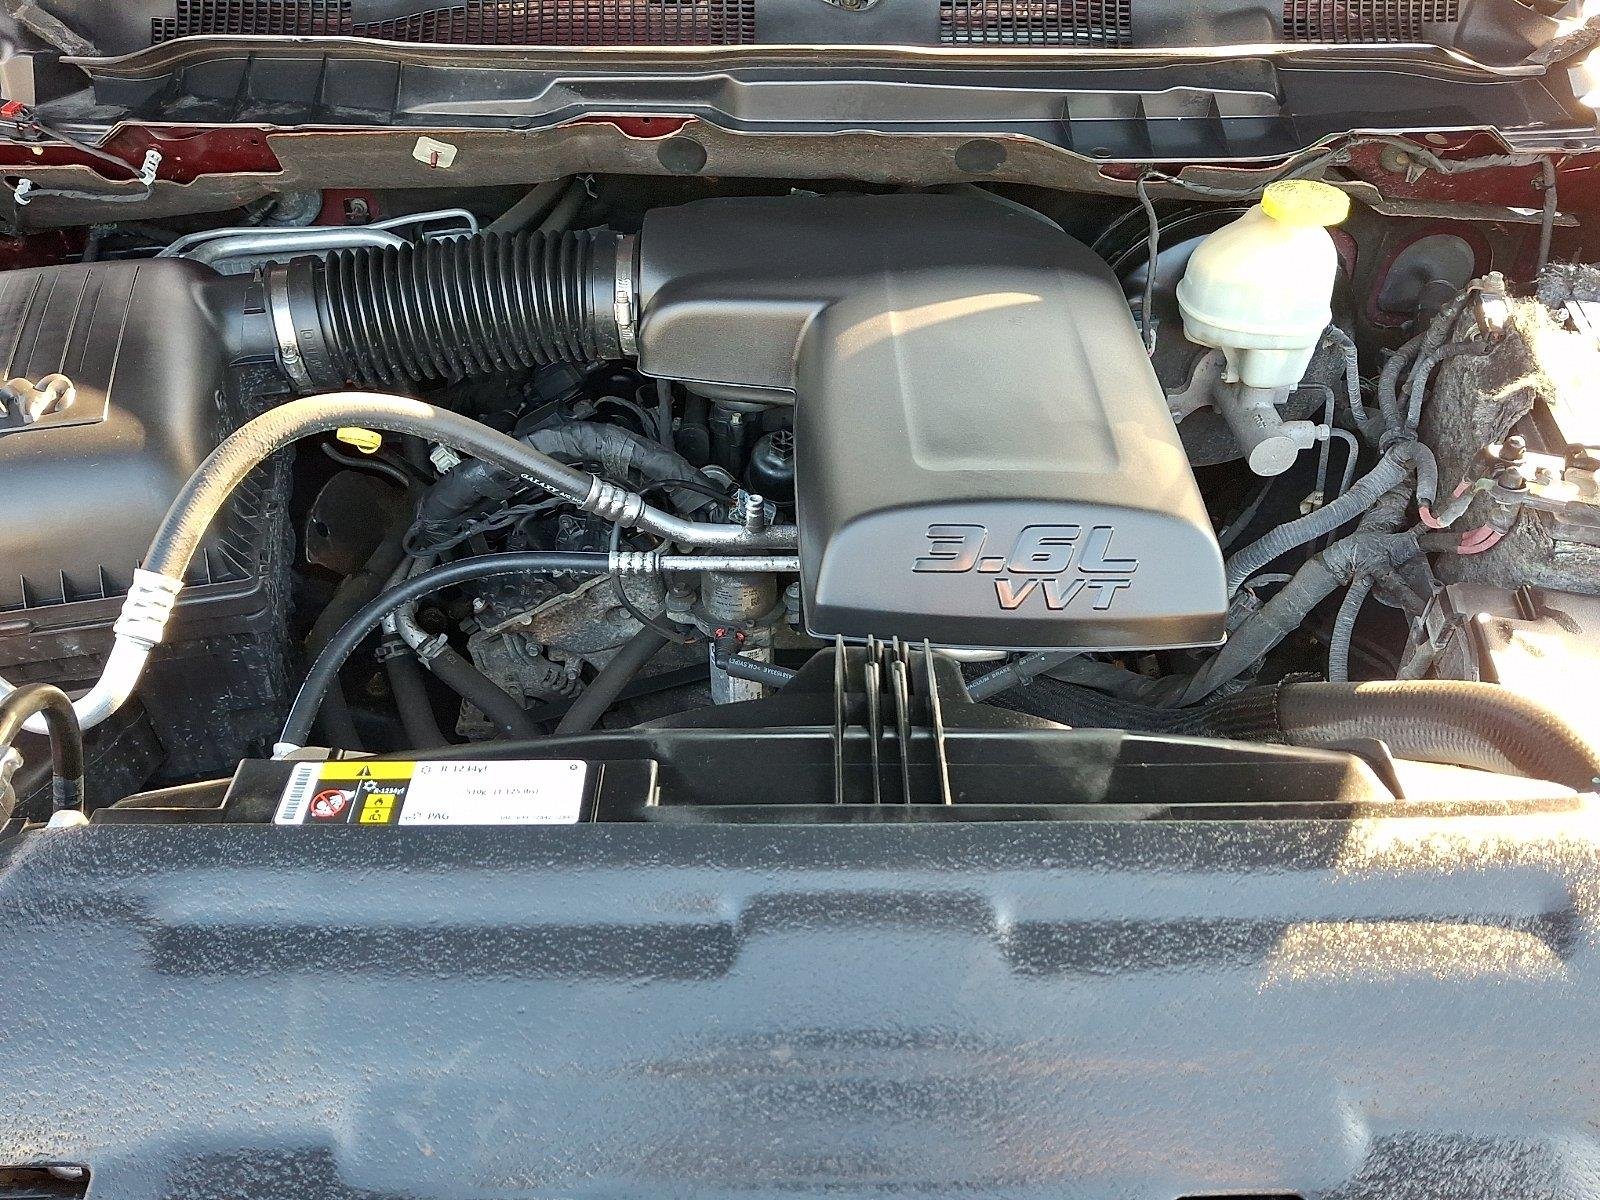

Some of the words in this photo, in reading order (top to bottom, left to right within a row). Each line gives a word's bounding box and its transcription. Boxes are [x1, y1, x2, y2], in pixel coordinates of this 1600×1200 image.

[520, 473, 559, 493] GALAXY
[912, 523, 1140, 574] 3.6L
[994, 578, 1132, 610] VVT
[965, 677, 990, 691] VACUUM
